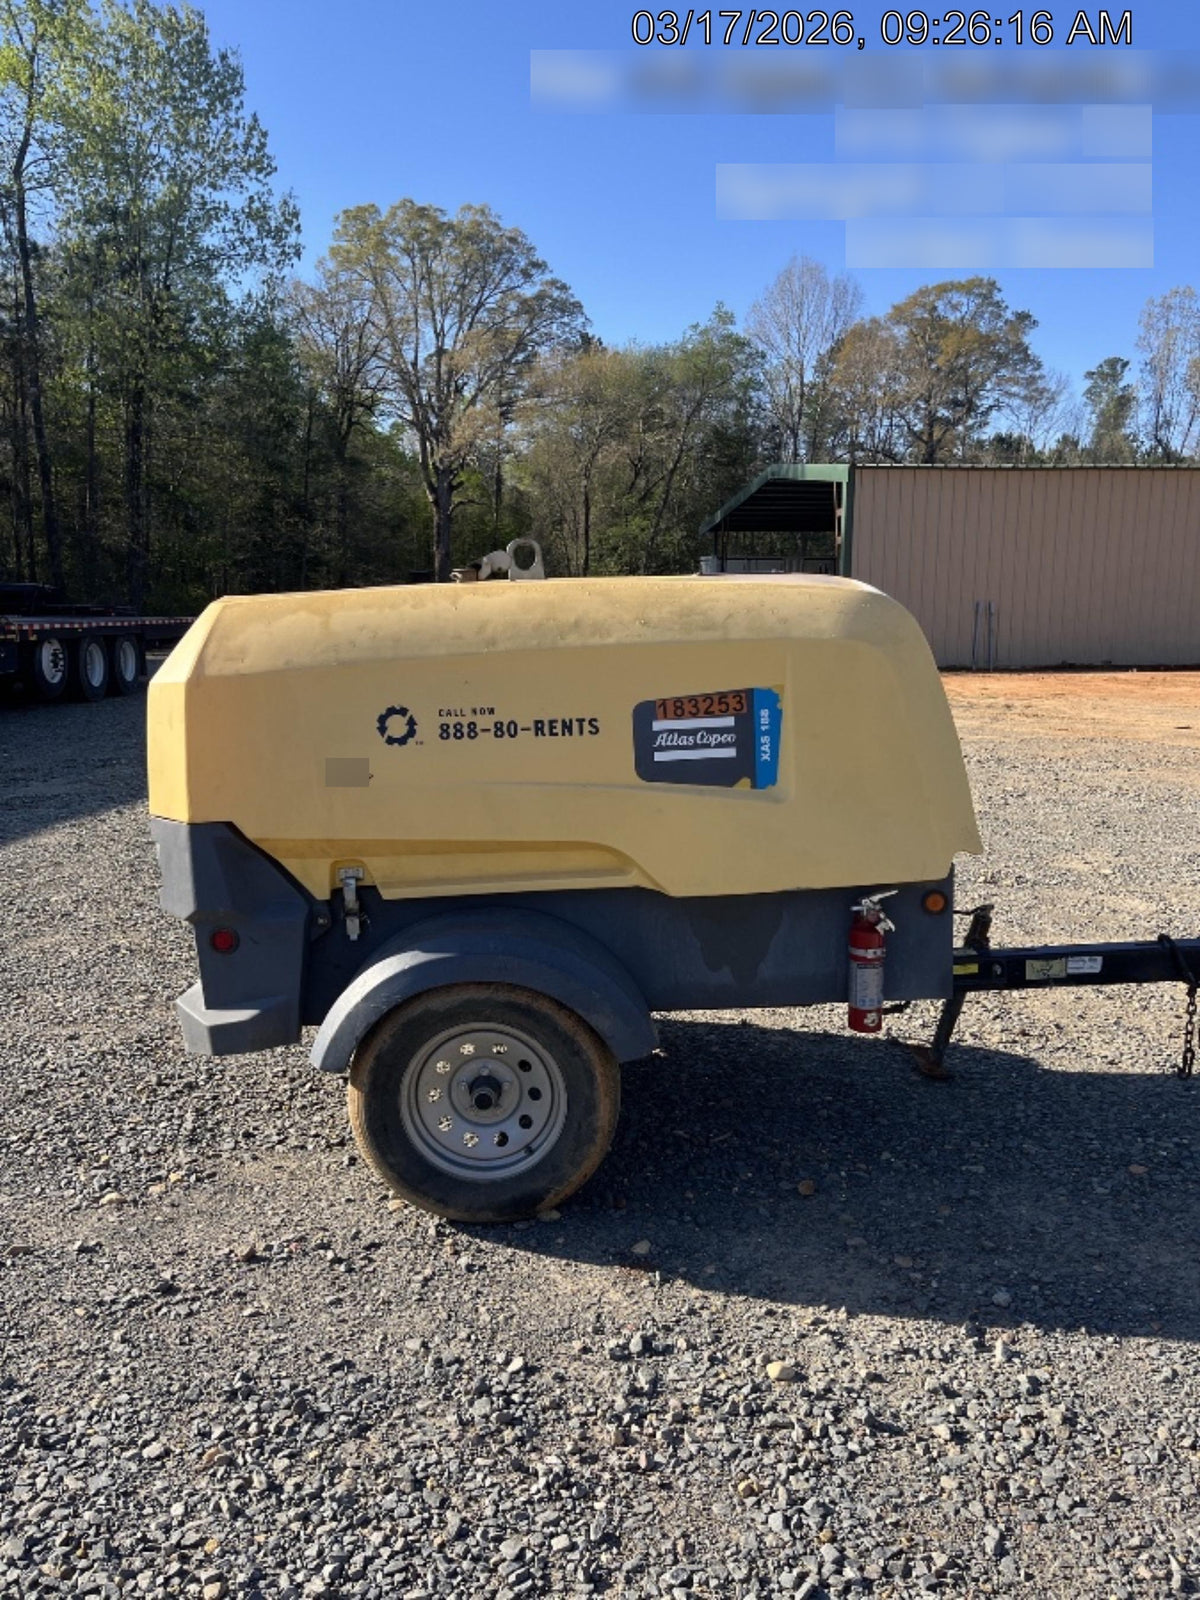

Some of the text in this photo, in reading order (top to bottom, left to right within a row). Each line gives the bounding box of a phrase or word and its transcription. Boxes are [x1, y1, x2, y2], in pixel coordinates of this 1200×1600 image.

[438, 707, 496, 718] CALL NOW
[658, 694, 745, 718] 183253
[438, 718, 601, 740] 888-80-RENTS
[652, 730, 736, 747] Atlas Copco
[760, 708, 771, 761] XAS 188
